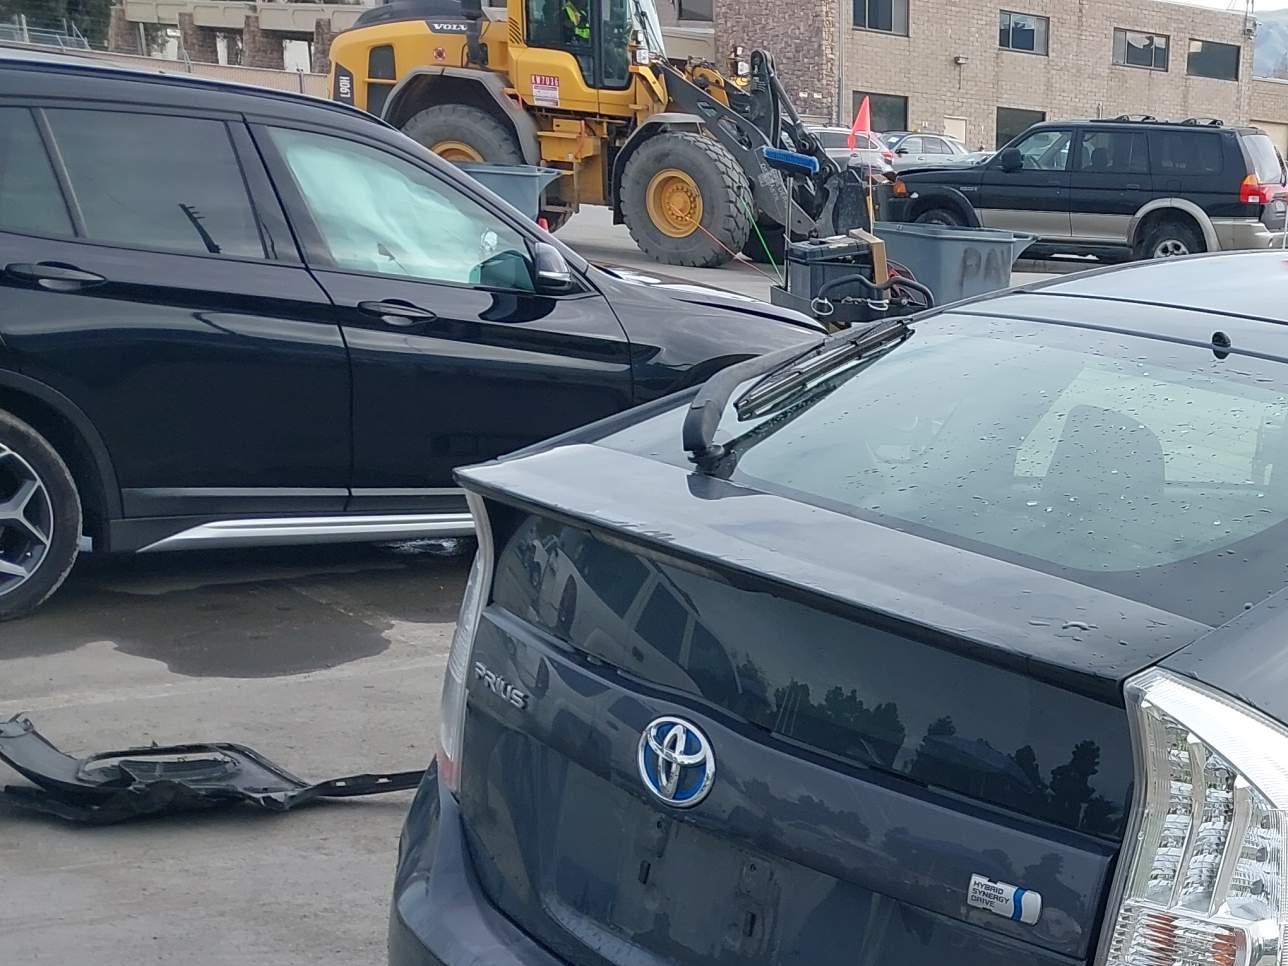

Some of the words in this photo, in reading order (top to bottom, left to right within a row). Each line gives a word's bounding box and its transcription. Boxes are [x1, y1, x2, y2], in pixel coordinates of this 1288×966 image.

[432, 23, 468, 31] VOLV
[475, 661, 525, 708] PRIUS
[973, 880, 1004, 895] HYBRID
[970, 895, 996, 908] DRIVE
[972, 888, 1010, 905] SYNERGY
